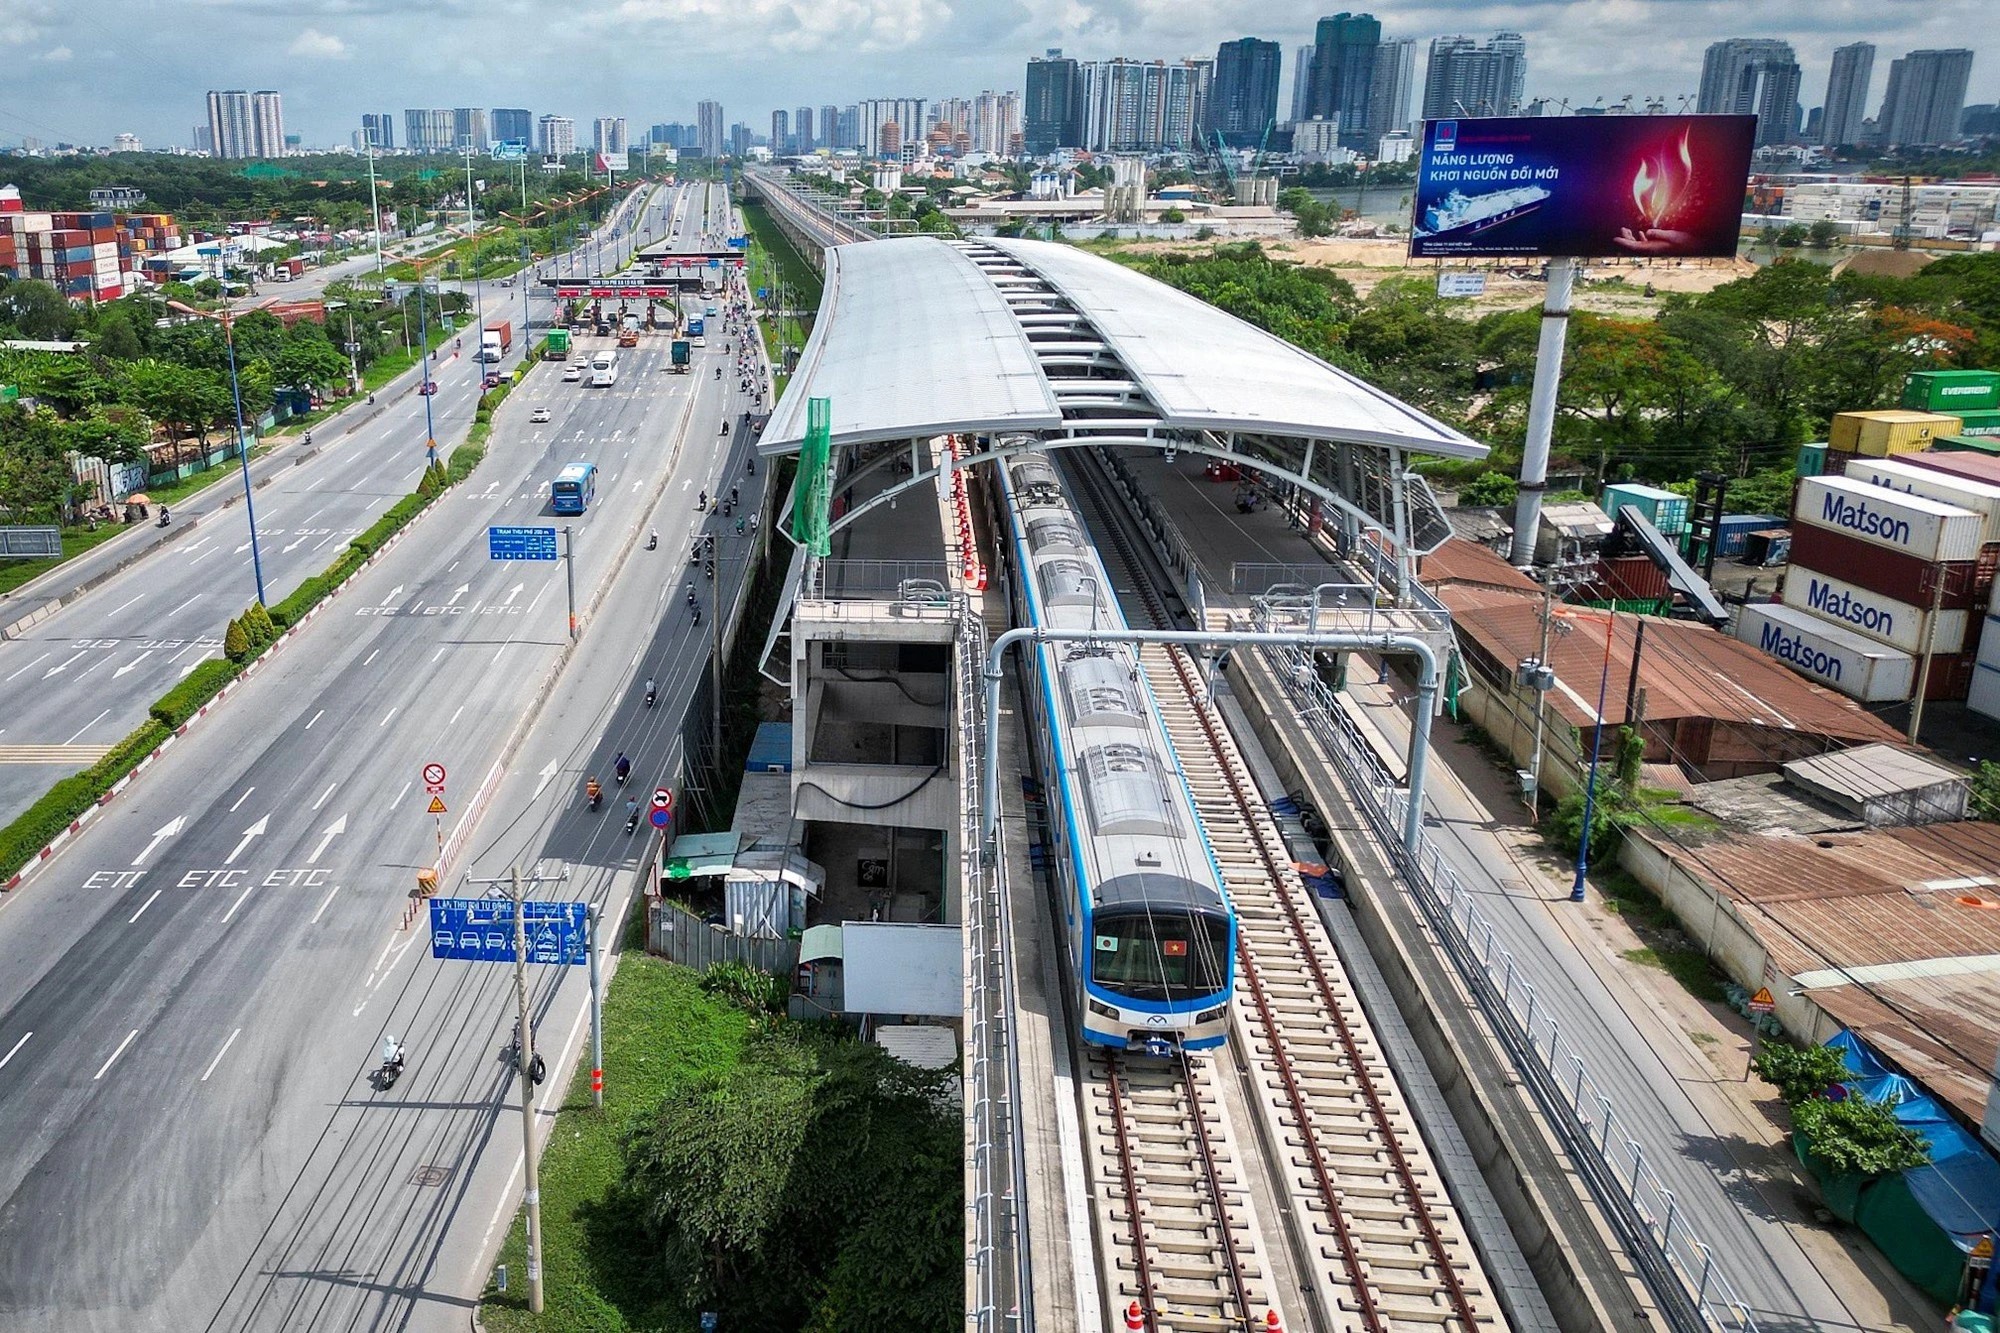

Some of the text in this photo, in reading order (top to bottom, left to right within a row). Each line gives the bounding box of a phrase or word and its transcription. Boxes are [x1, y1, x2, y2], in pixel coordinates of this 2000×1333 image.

[1432, 153, 1514, 167] NĂNG LƯỢNG
[1430, 170, 1460, 181] KHƠI
[1511, 166, 1532, 180] ĐỔI
[1535, 165, 1559, 179] MỚI
[1822, 492, 1909, 544] Matson
[355, 607, 399, 616] ETC
[423, 606, 465, 615] ETC
[480, 606, 522, 615] ETC
[1808, 579, 1893, 636] Matson
[1760, 622, 1842, 681] Matson
[176, 870, 249, 888] ETC
[261, 869, 333, 887] ETC
